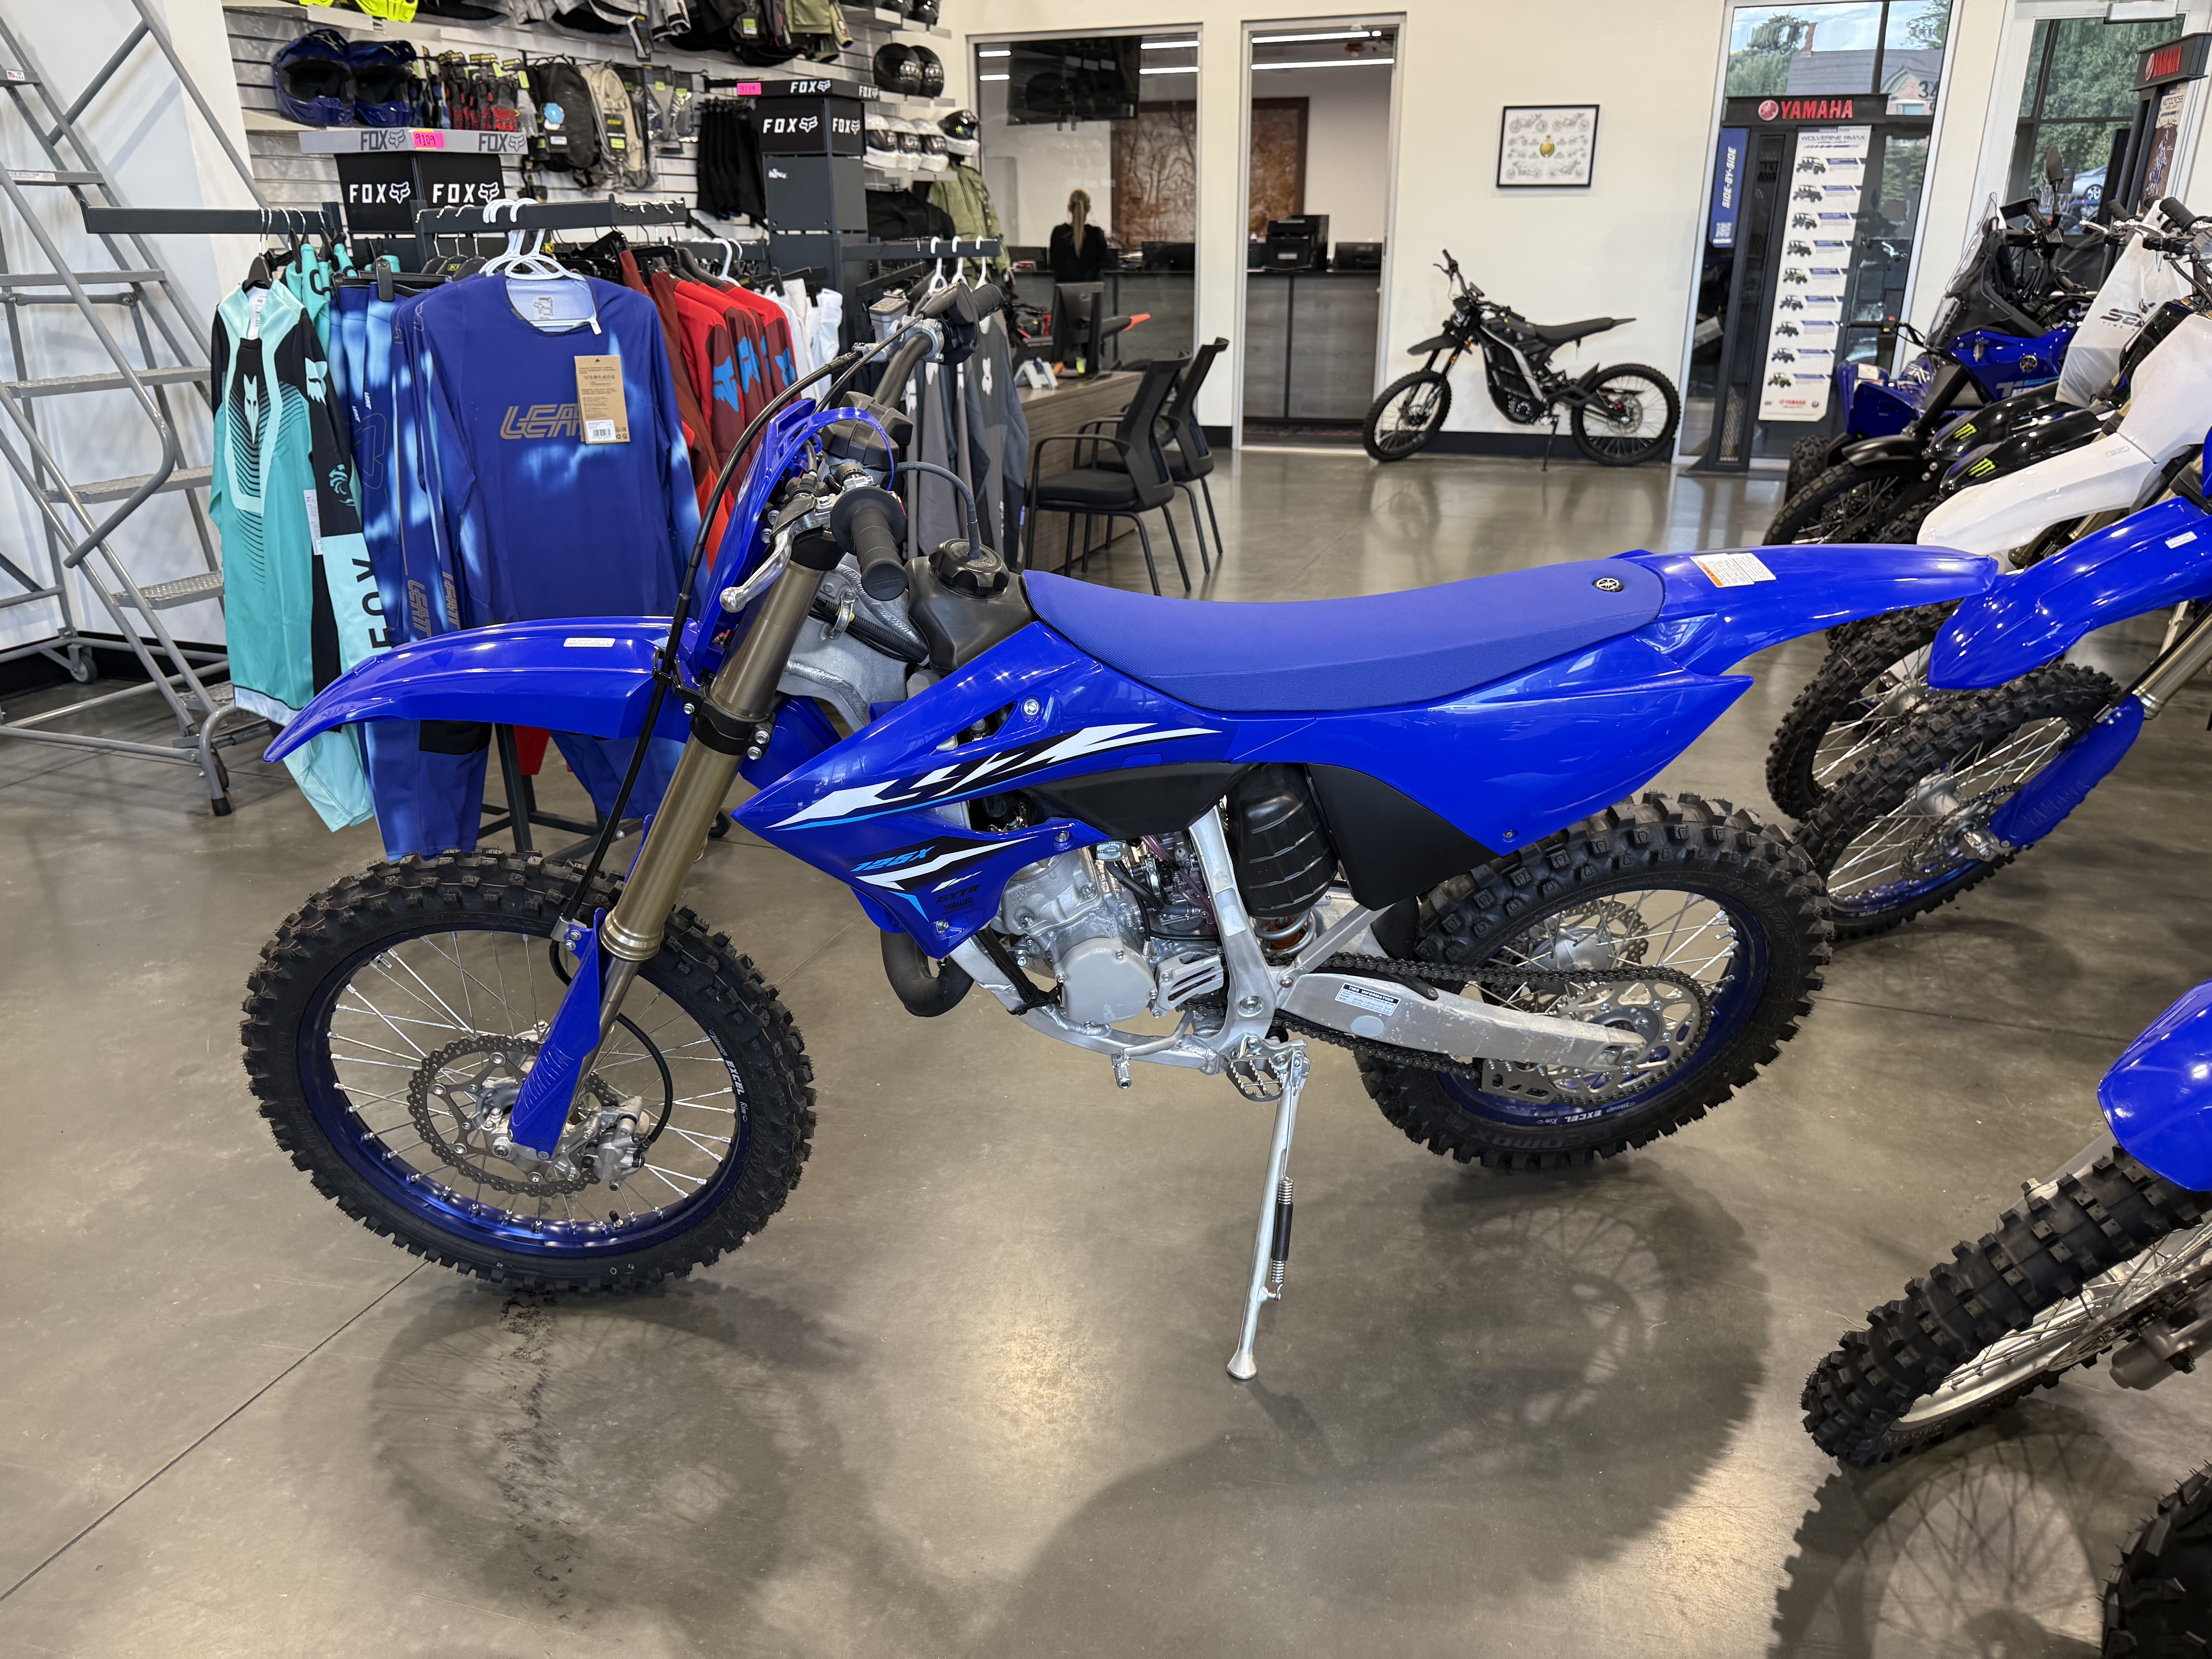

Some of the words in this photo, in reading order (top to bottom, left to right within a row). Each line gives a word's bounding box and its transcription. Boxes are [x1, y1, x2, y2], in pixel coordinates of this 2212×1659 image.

[790, 81, 817, 93] FOX
[859, 85, 872, 98] FOX
[1781, 100, 1853, 119] YAMAHA
[763, 118, 798, 134] FOX
[833, 118, 850, 134] FOX
[361, 130, 388, 151] FOX
[479, 133, 508, 152] FOX
[1722, 146, 1737, 209] SIDE-BY-SIDE
[349, 183, 386, 204] FOX
[433, 183, 476, 204] FOX
[850, 845, 938, 872] 125X
[936, 884, 981, 904] GYTR
[944, 897, 973, 911] YAMALUBE
[1361, 989, 1394, 1002] INFORMATION
[726, 1060, 745, 1095] EXCEL
[1564, 1109, 1602, 1123] EXCEL
